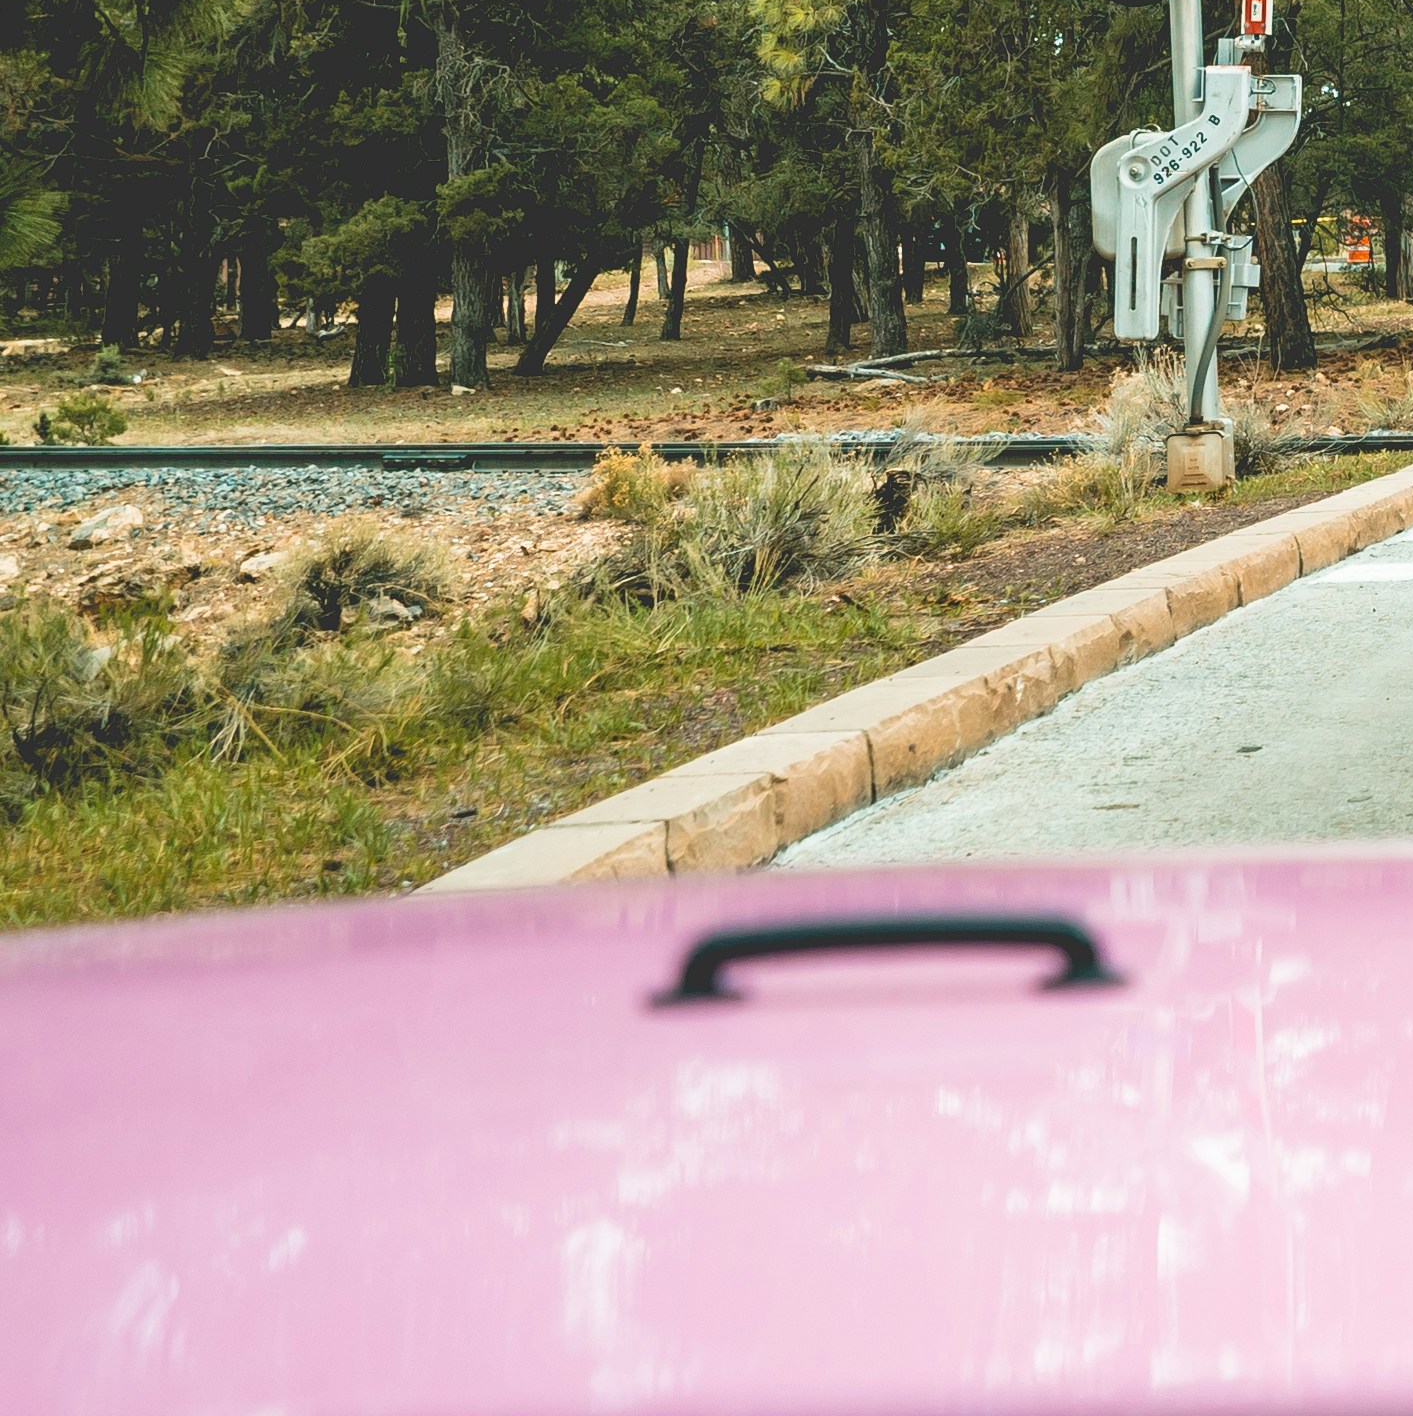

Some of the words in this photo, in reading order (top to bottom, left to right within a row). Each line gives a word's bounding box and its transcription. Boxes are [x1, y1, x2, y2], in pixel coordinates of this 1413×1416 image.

[1150, 135, 1179, 167] DOT
[1153, 131, 1208, 185] 926-922
[1208, 114, 1221, 126] B
